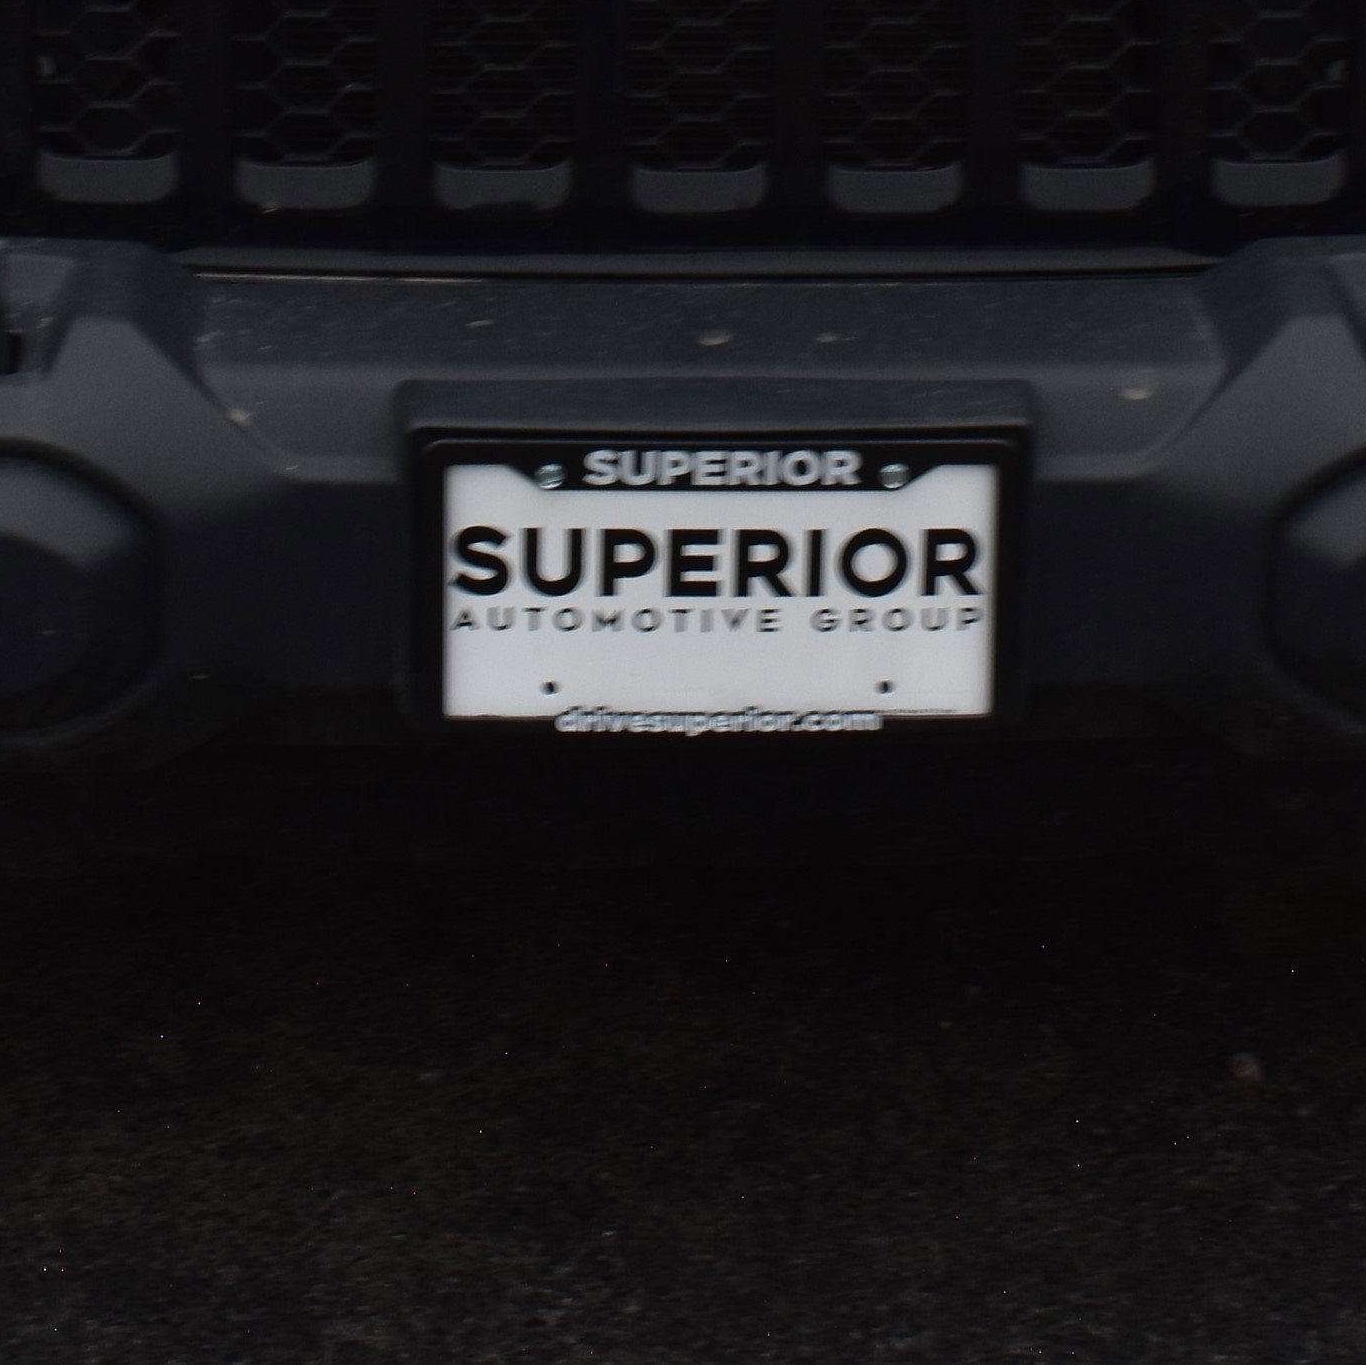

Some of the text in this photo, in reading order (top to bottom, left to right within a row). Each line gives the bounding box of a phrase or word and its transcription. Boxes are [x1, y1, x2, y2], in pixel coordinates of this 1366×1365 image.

[582, 448, 863, 488] SUPERIOR
[449, 525, 983, 597] SUPERIOR
[451, 607, 986, 633] AUTOMOTIVE GROUP
[554, 707, 885, 733] drivesuperior.com
